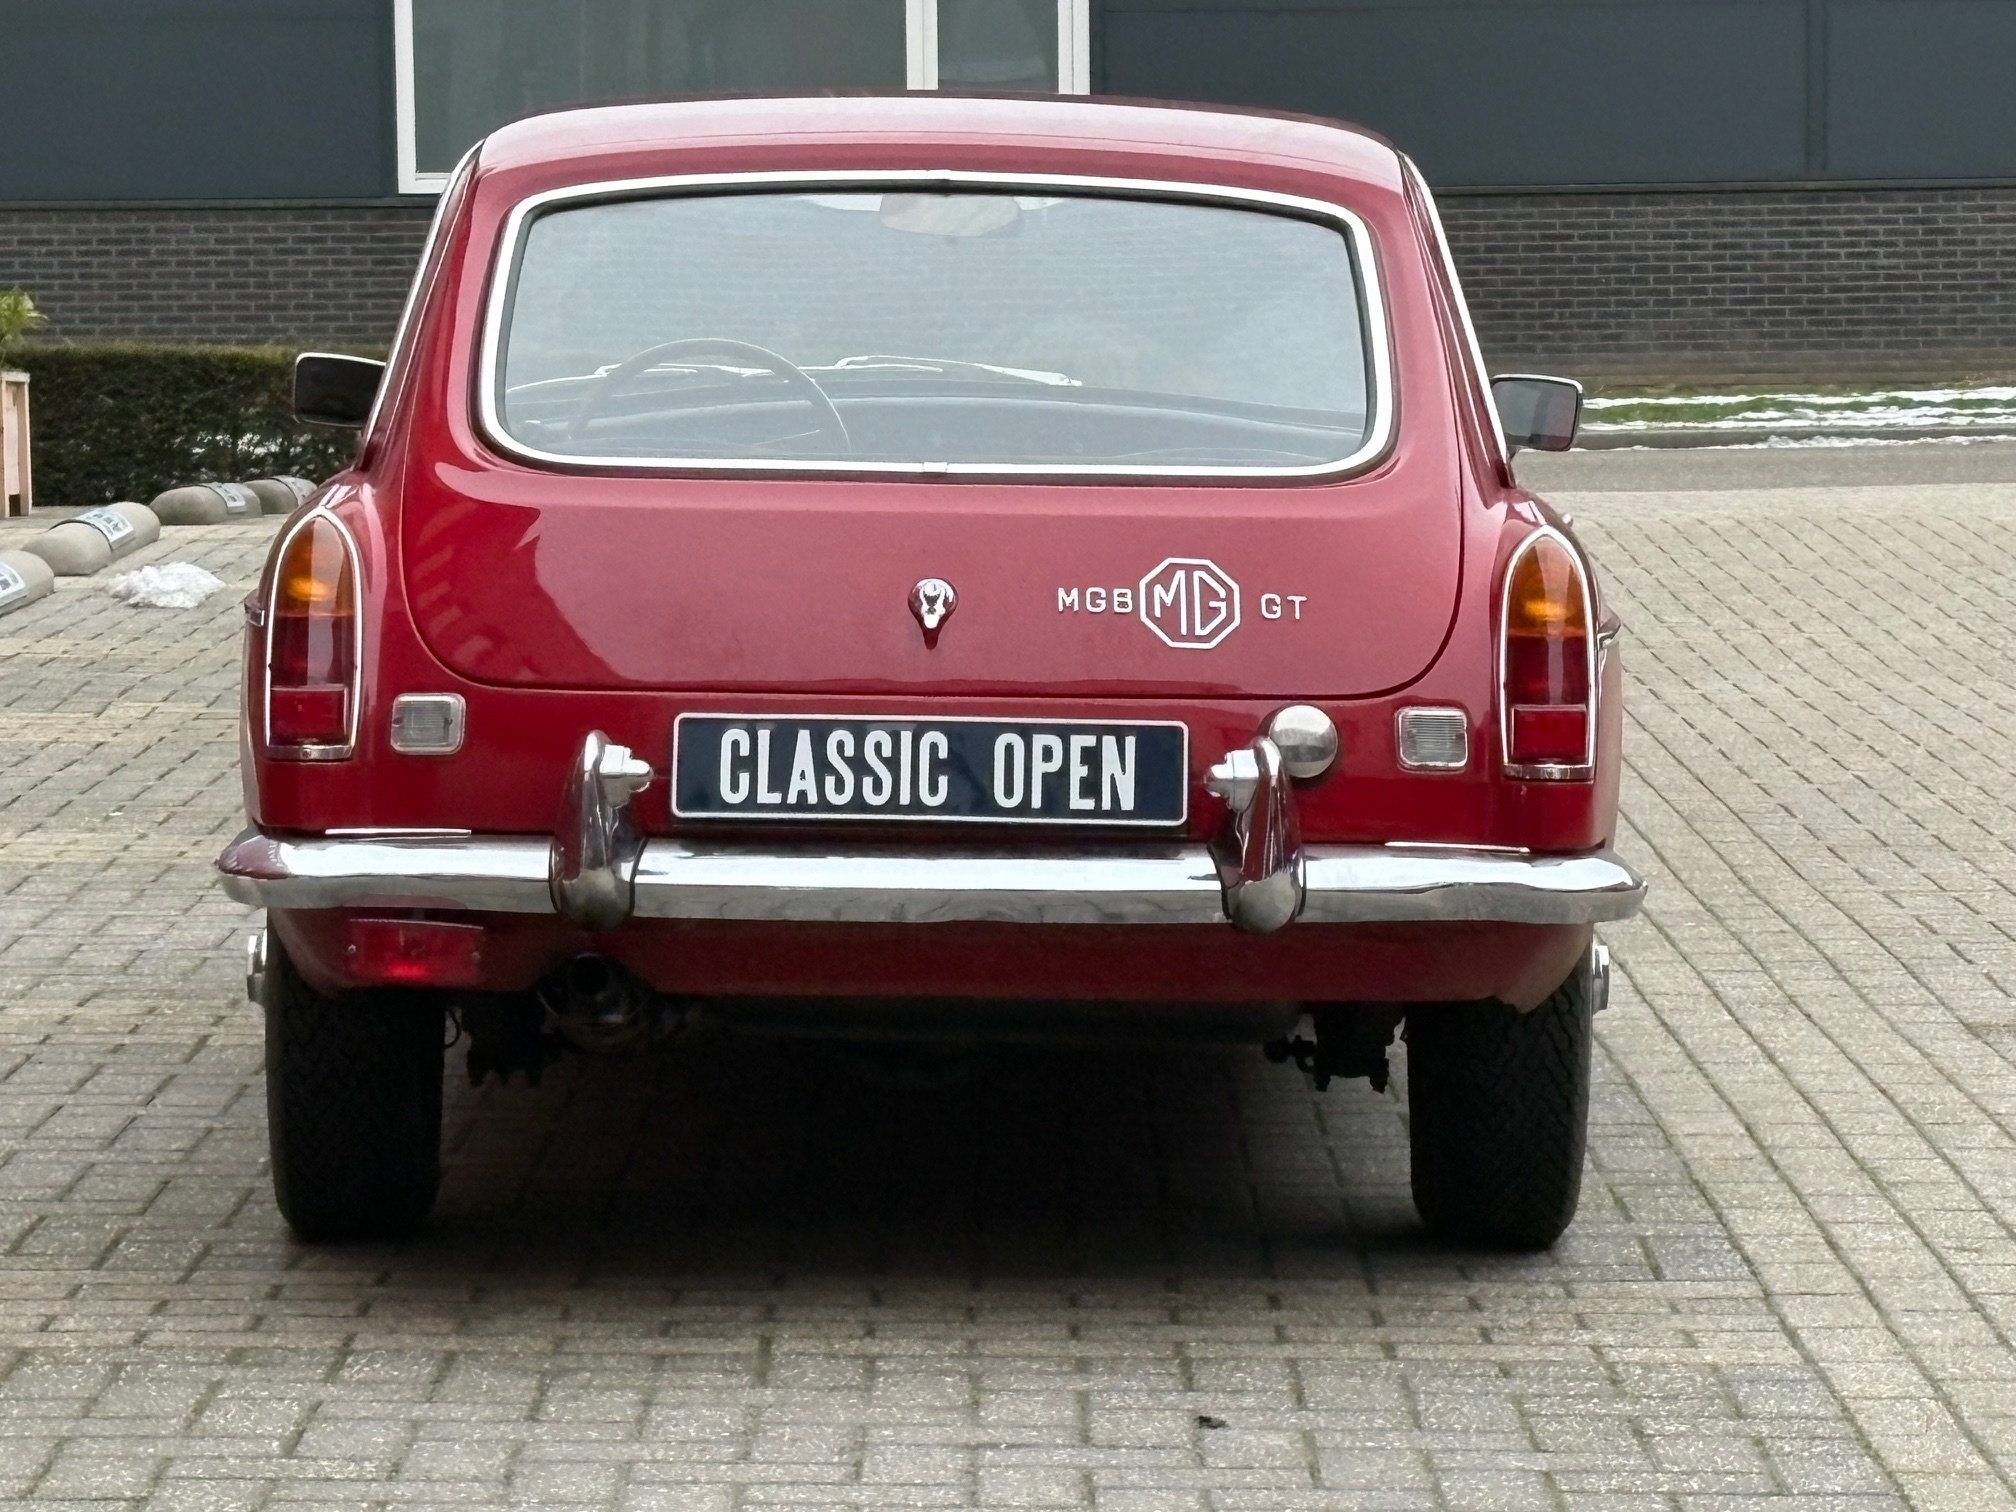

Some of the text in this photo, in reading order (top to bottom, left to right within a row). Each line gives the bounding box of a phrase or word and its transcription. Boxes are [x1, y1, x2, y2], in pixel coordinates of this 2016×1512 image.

[1058, 570, 1307, 636] MGB MG GT
[720, 729, 1136, 811] CLASSIC OPEN
